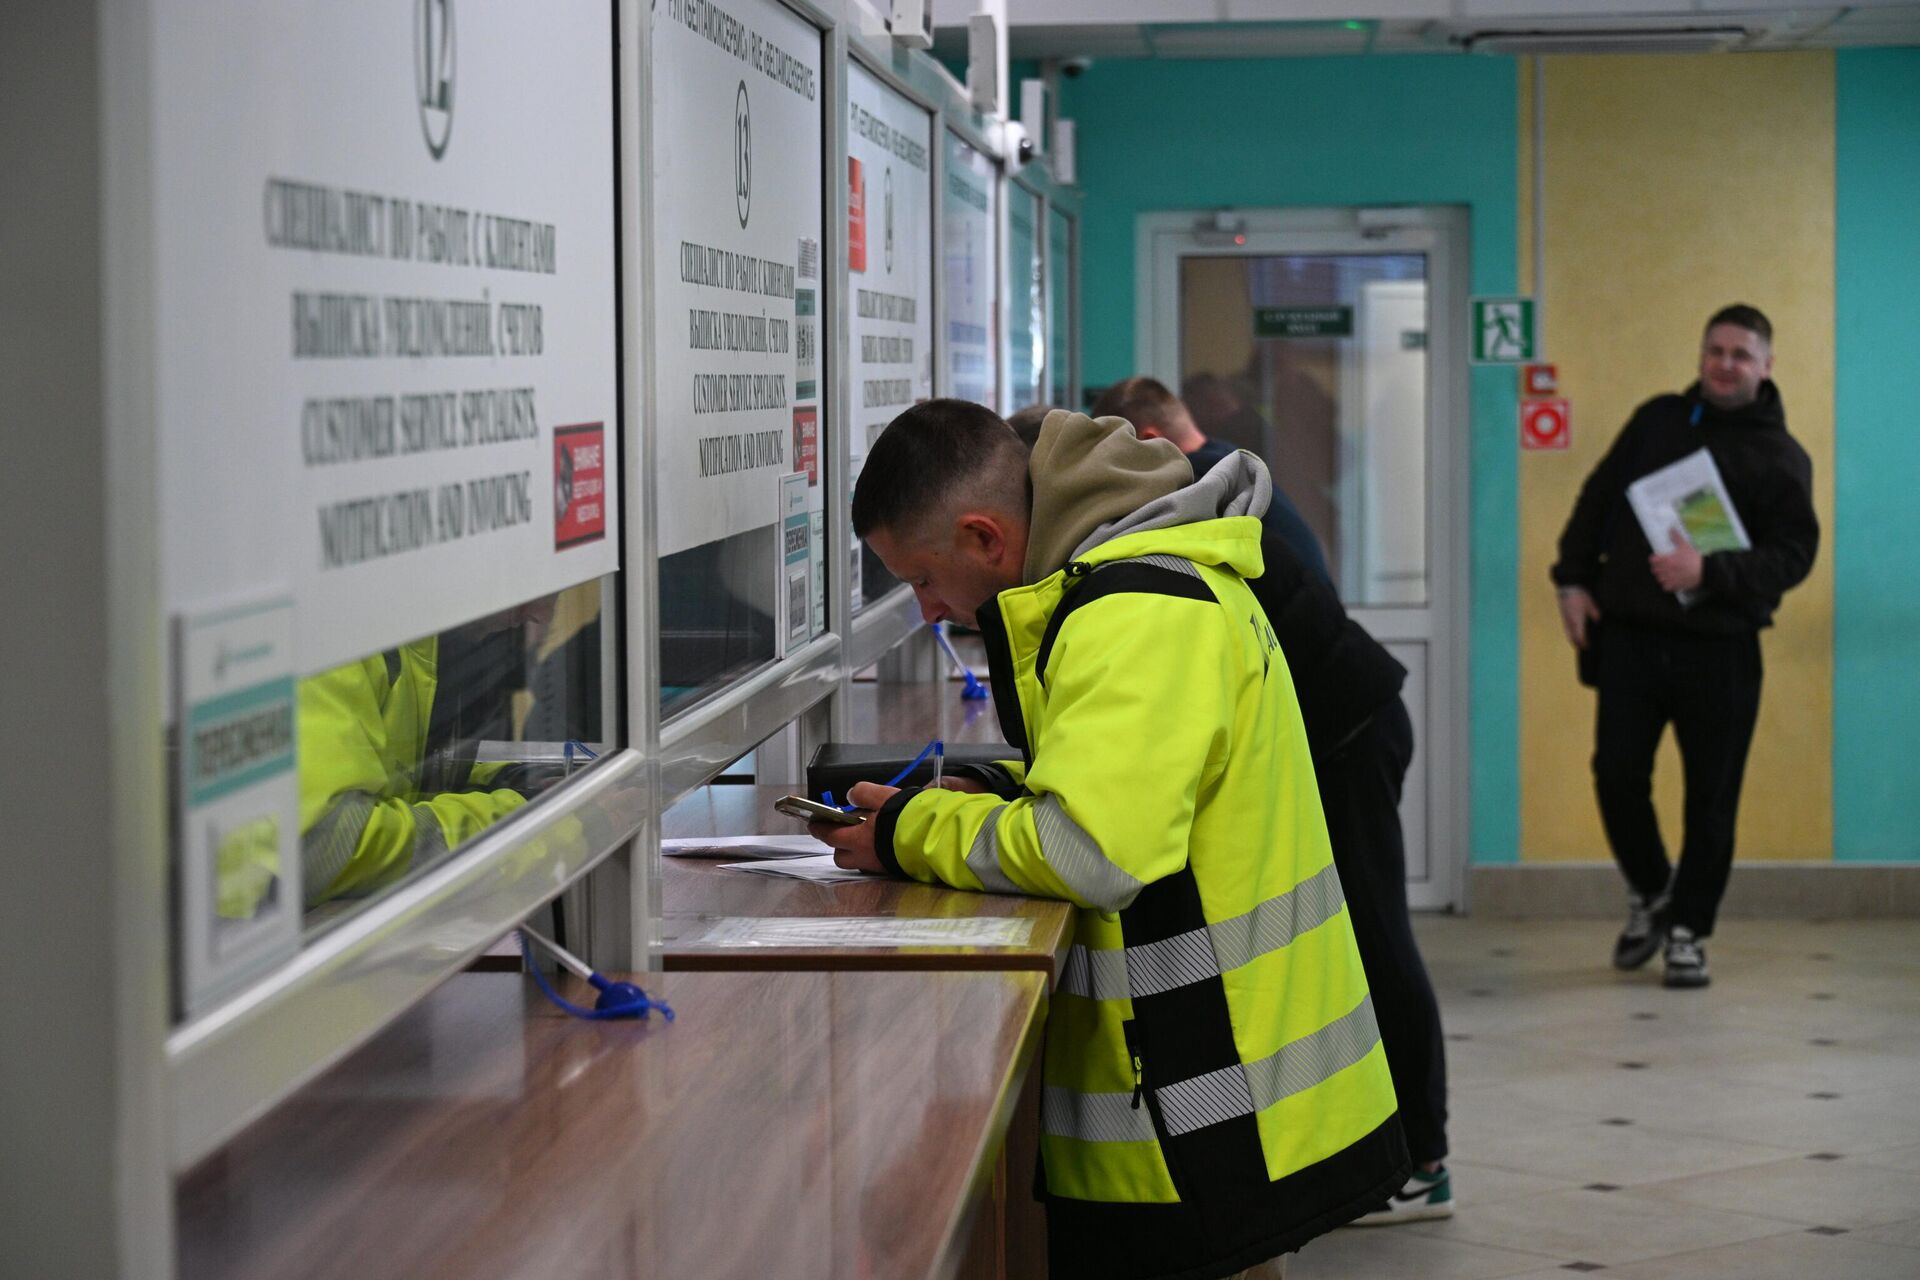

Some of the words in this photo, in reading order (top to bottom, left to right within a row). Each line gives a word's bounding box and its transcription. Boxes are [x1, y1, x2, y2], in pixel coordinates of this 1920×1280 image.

[752, 31, 763, 72] RUE
[737, 113, 749, 200] 13
[417, 203, 469, 267] РАБОТЕ
[473, 212, 481, 268] С
[485, 215, 556, 274] КЛИЕНТАМИ
[680, 240, 724, 289] СПЕЦИАЛИСТ
[725, 251, 734, 290] ПО
[735, 254, 757, 294] РАБОТЕ
[758, 259, 763, 295] С
[763, 260, 794, 299] КЛИЕНТАМИ
[498, 302, 543, 356] СЧЕТОВ
[689, 308, 722, 350] ВЫПИСКА
[769, 318, 789, 353] СЧЕТОВ
[693, 374, 728, 414] CUSTOMER
[728, 374, 752, 412] SERVICE
[301, 394, 395, 469] CUSTOMER
[400, 390, 457, 456] SERVICE
[698, 433, 742, 478] NOTIFICATION
[743, 433, 755, 470] AND
[756, 429, 783, 468] INVOICING
[318, 486, 433, 571] NOTIFICATION
[438, 482, 463, 544] AND
[467, 469, 532, 537] INVOICING
